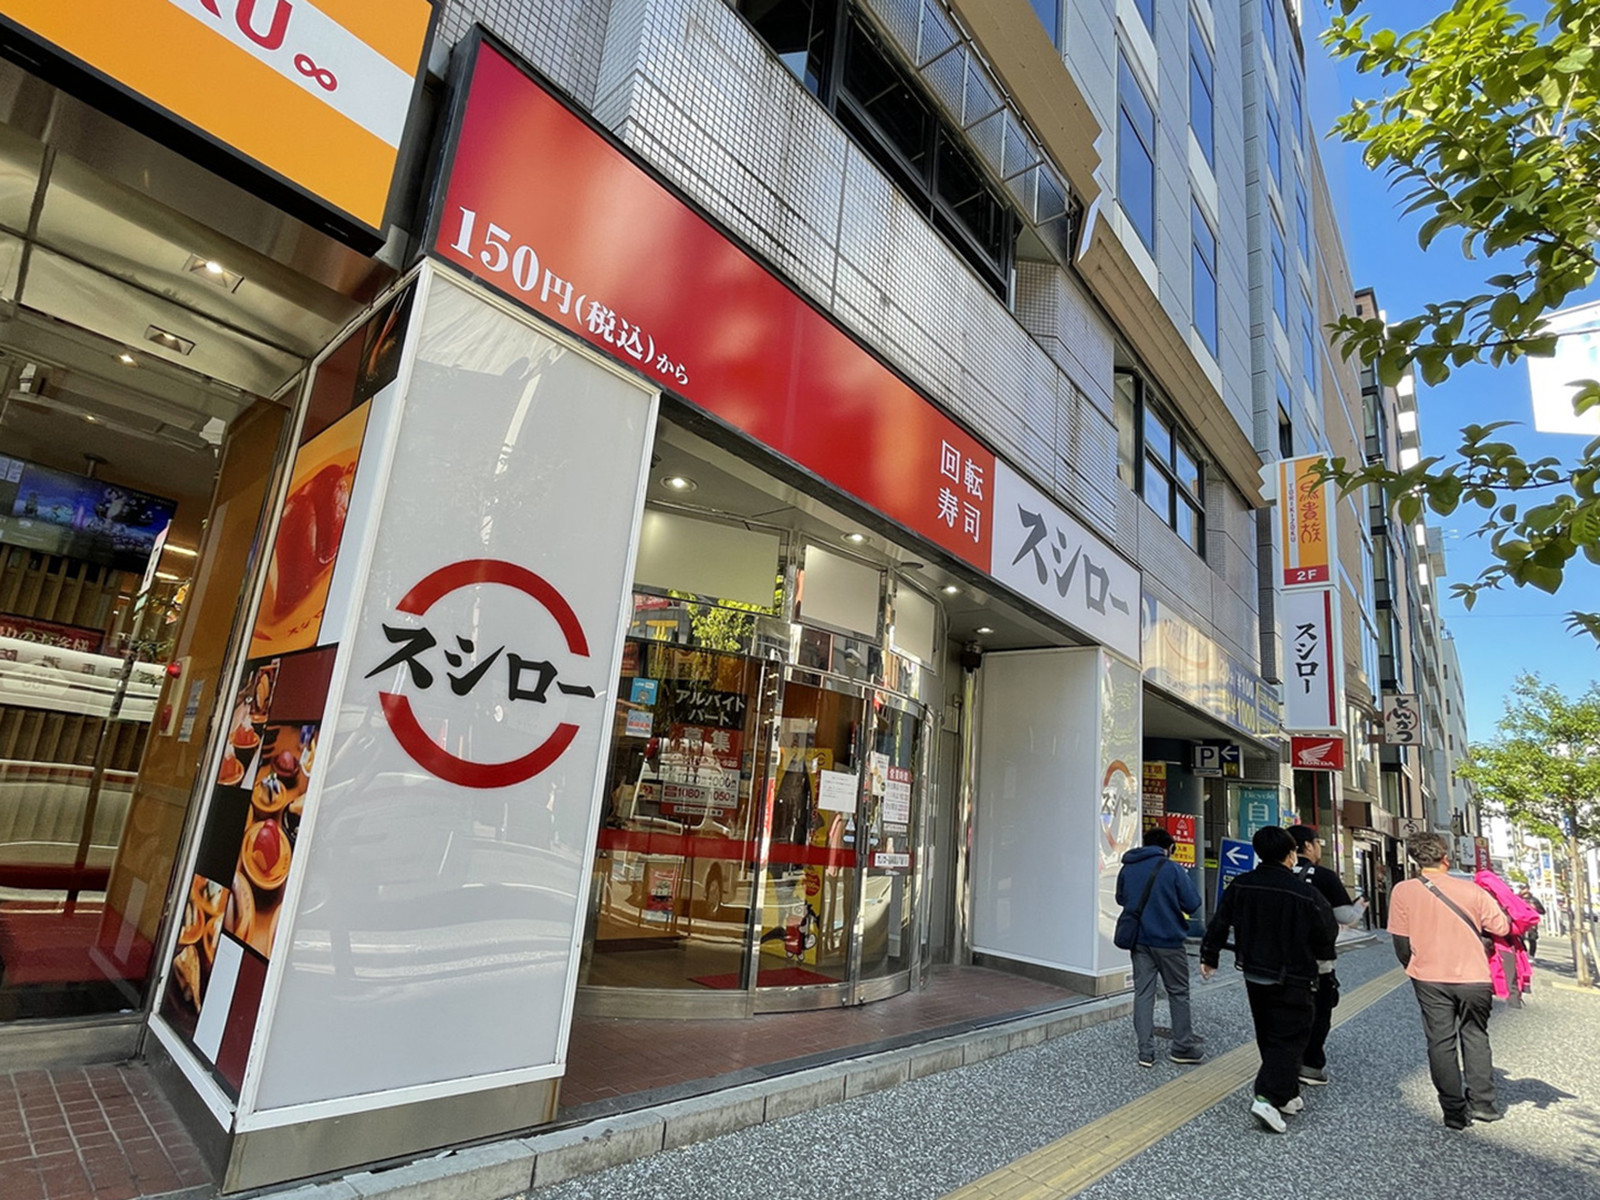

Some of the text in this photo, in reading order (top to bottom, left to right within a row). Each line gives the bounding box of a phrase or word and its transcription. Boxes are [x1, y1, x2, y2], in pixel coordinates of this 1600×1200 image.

[200, 0, 293, 50] U
[450, 206, 689, 386] 150円(税込)から
[940, 439, 983, 501] 回転
[937, 487, 981, 543] 寿司
[1011, 503, 1130, 616] スシロー
[1297, 569, 1317, 581] 2F
[364, 622, 596, 704] スシロー
[1294, 622, 1320, 695] スシロー
[676, 688, 745, 712] アルバイト
[1392, 697, 1414, 742] とんかつ
[1200, 748, 1214, 767] P
